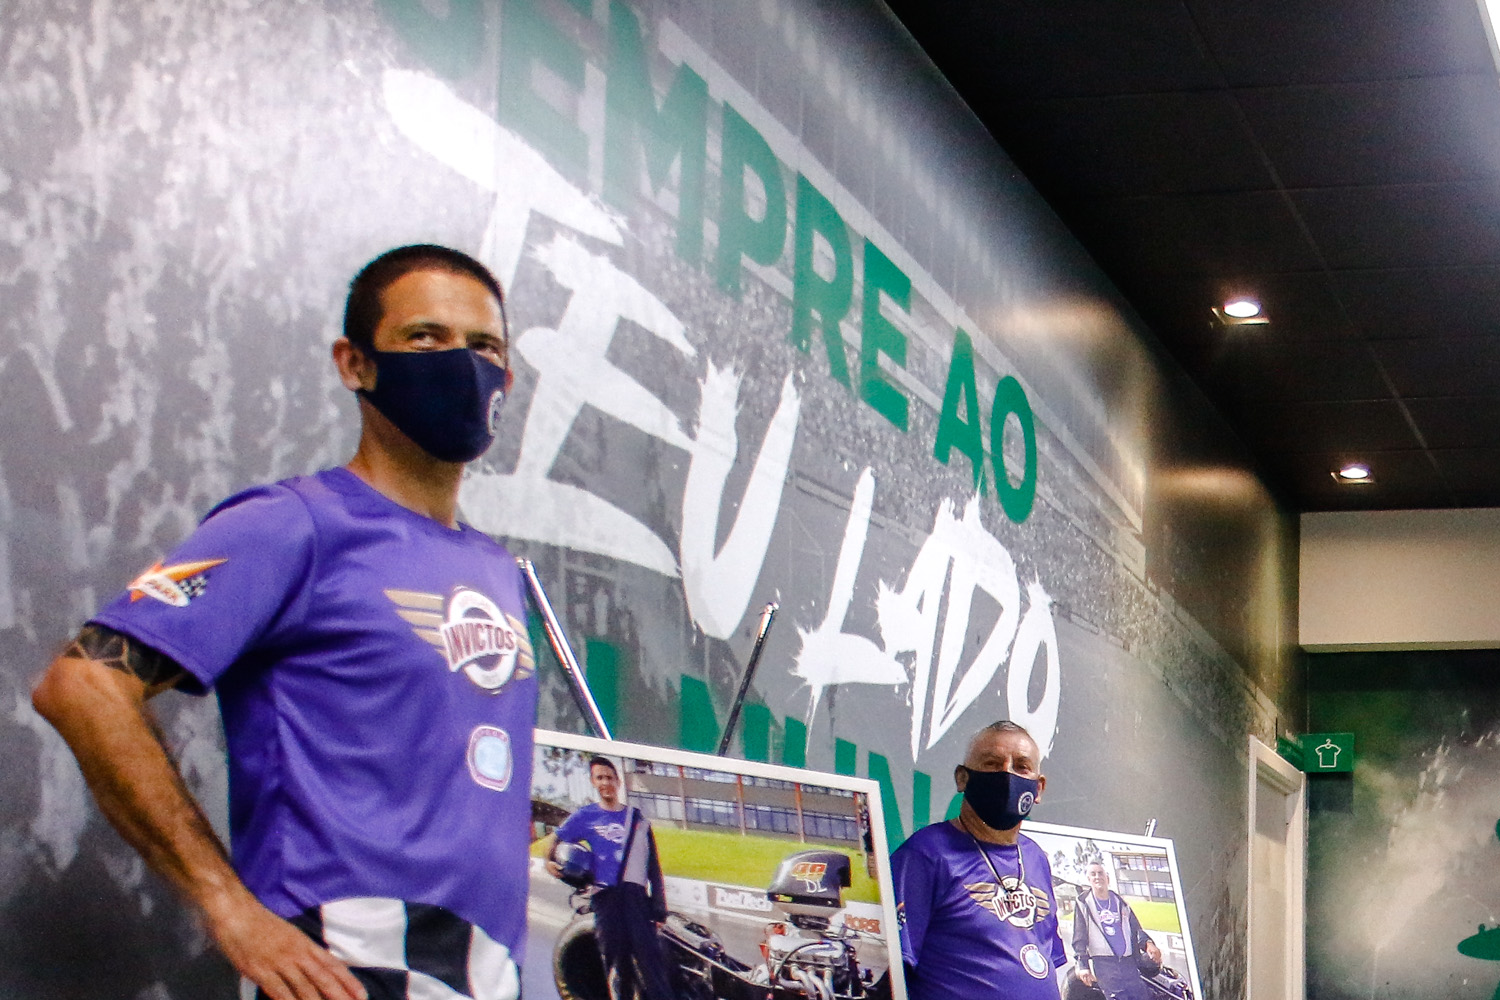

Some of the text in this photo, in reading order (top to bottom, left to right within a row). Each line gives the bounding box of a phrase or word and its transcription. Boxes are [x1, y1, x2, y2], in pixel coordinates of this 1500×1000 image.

[934, 325, 1038, 525] AO
[443, 621, 516, 665] INVICTOS
[790, 464, 1062, 768] LADO
